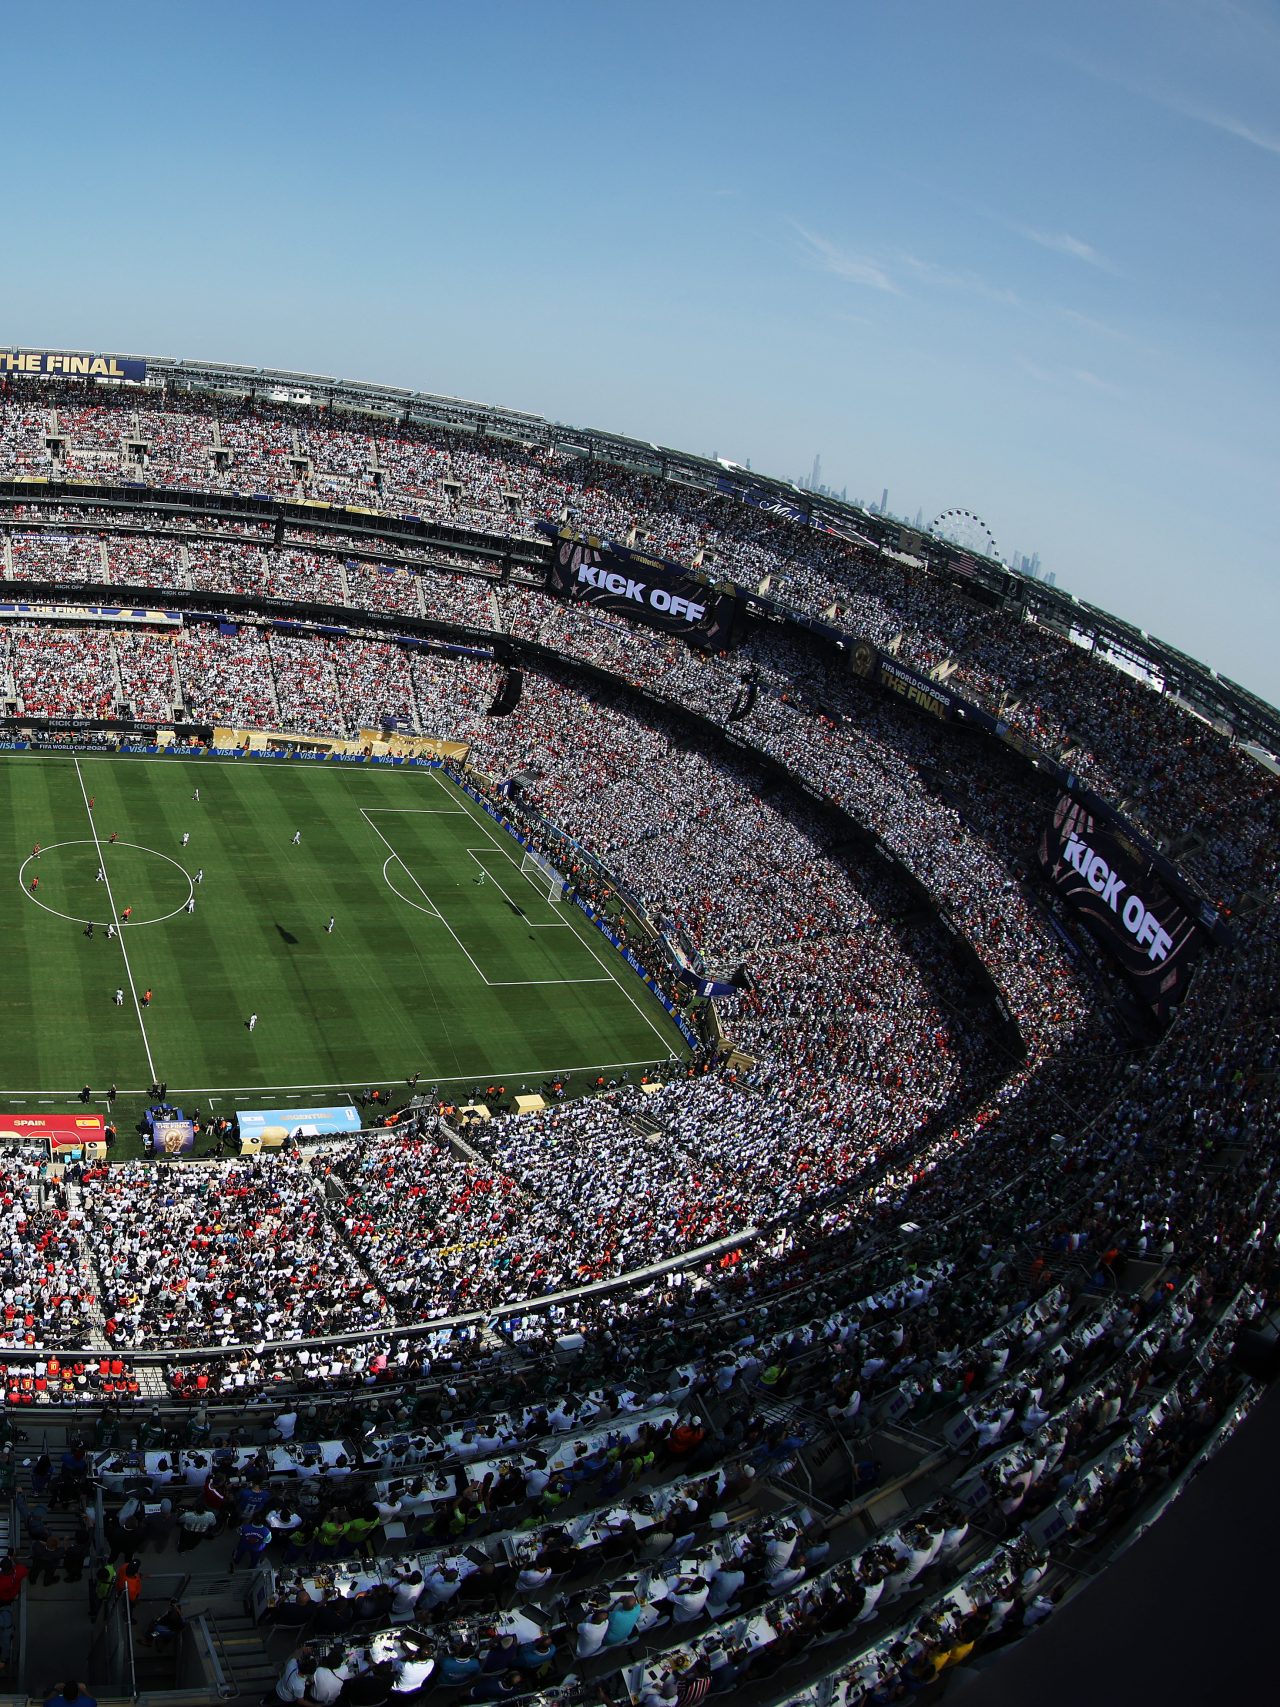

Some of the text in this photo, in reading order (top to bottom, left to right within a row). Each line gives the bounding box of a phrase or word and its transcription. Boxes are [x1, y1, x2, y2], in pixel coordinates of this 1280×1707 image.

[46, 355, 124, 376] FINAL
[577, 563, 706, 622] KICK OFF
[882, 662, 950, 706] FIFA WORLD CUP 2026
[881, 670, 946, 720] THE FINAL
[487, 806, 497, 818] VISA
[509, 823, 519, 839] VISA
[576, 895, 587, 913] VISA
[1063, 831, 1126, 913] KICK
[1122, 895, 1173, 961] OFF
[601, 922, 612, 941] VISA
[627, 952, 639, 972] VISA
[654, 984, 666, 1005] VISA
[679, 1019, 690, 1041] VISA
[50, 1363, 57, 1371] 10
